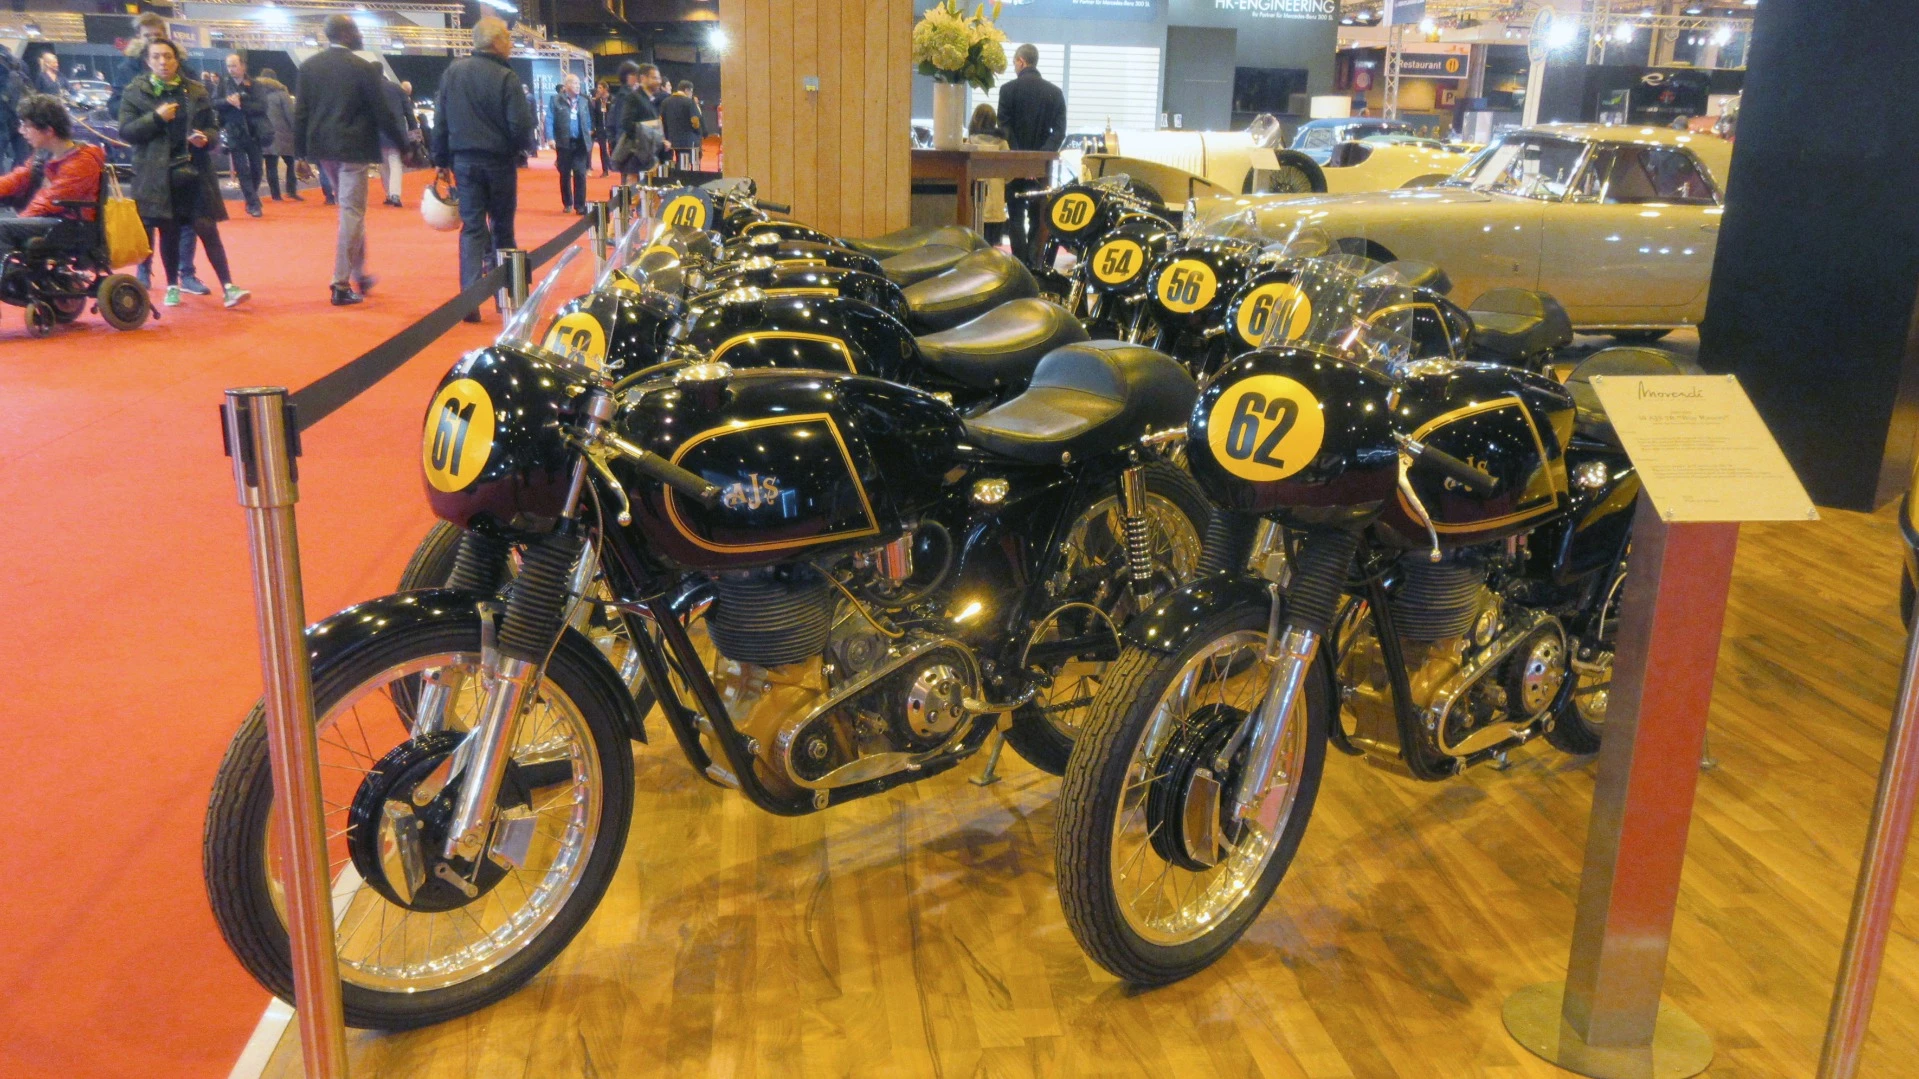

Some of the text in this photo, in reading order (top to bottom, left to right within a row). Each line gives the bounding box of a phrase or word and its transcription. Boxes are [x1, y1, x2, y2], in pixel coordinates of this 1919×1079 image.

[1215, 0, 1335, 13] HK-ENGINEERING
[670, 204, 698, 227] 49
[1058, 199, 1088, 226] 50
[1101, 248, 1135, 277] 54
[1166, 267, 1204, 305] 56
[1247, 293, 1296, 338] 60
[551, 325, 593, 365] 58
[431, 397, 477, 477] 61
[1225, 391, 1299, 470] 62
[723, 473, 779, 510] AJS
